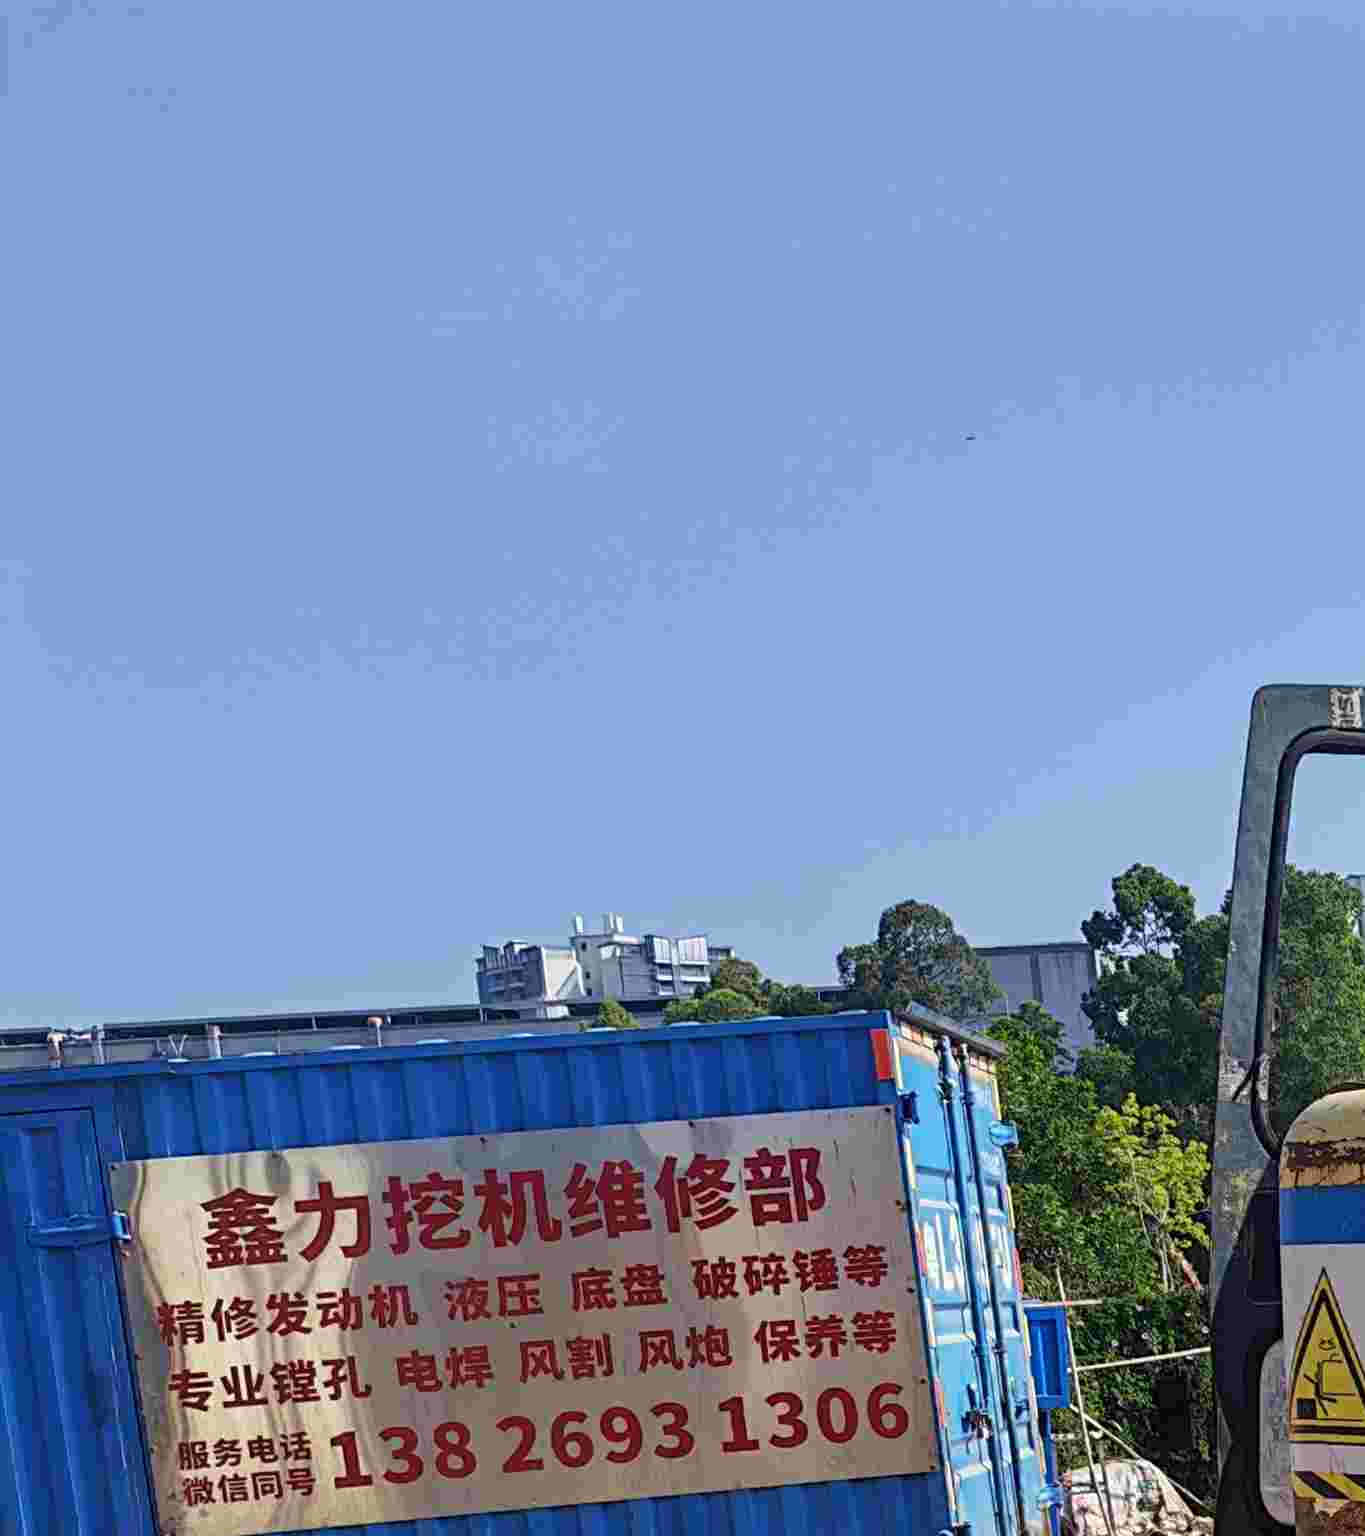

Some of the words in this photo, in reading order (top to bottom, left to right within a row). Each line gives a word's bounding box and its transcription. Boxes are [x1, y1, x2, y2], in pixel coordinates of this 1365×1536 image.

[201, 1146, 826, 1270] 鑫力挖机维修部
[157, 1284, 418, 1346] 精修发动机
[444, 1272, 542, 1322] 液压
[570, 1265, 666, 1312] 底盘
[692, 1245, 890, 1301] 破碎锤等
[169, 1356, 371, 1412] 专业镗孔
[396, 1345, 494, 1392] 电焊
[518, 1334, 614, 1382] 风割
[638, 1326, 732, 1374] 风炮
[754, 1311, 896, 1364] 保养等
[178, 1432, 312, 1471] 服务电话
[330, 1421, 478, 1489] 138
[495, 1400, 695, 1474] 2693
[719, 1382, 910, 1453] 1306
[181, 1468, 316, 1506] 微信同号
